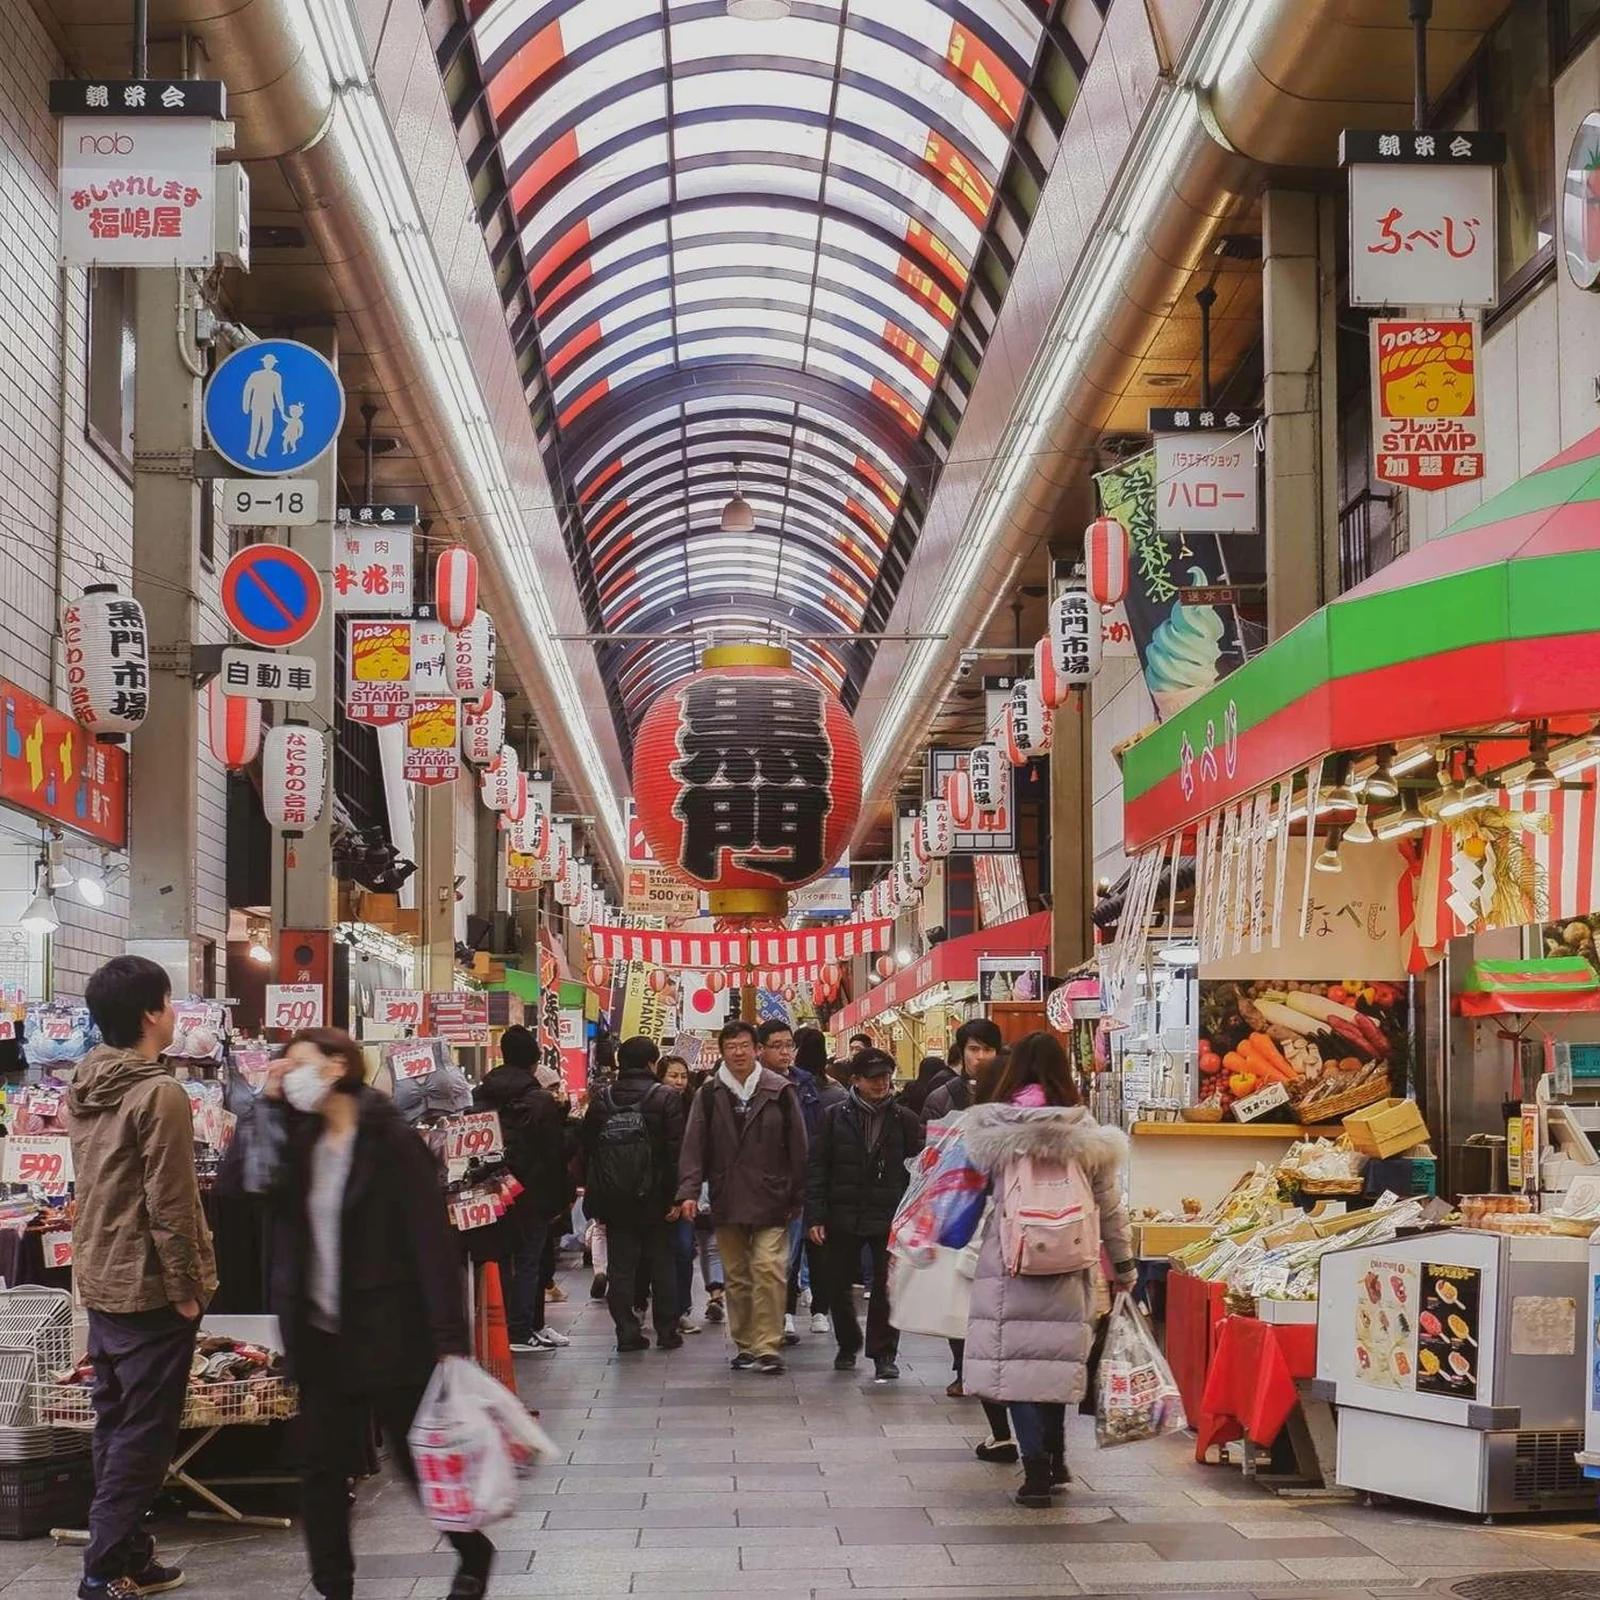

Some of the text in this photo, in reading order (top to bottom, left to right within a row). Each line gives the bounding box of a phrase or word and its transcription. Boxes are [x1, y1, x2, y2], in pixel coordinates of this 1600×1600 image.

[79, 132, 134, 155] nob
[70, 176, 202, 211] おしゃれします
[89, 206, 182, 239] 福嶋屋
[1381, 327, 1441, 351] クロモン
[1389, 418, 1465, 433] フレッシュ
[1382, 433, 1477, 452] STAMP
[1172, 453, 1240, 467] バラエティショップ
[1384, 455, 1478, 477] 加盟店
[1168, 483, 1245, 508] ハロー
[354, 626, 392, 639] クロモン
[1060, 597, 1090, 674] 黒門市場
[64, 606, 97, 724] なにわの台所
[105, 601, 147, 720] 黒門市場
[227, 662, 312, 690] 自動車
[357, 682, 403, 691] フレッシュ
[351, 690, 410, 702] STAMP
[351, 704, 411, 718] 加盟店
[1012, 683, 1032, 750] 黒門市場
[407, 756, 456, 766] STAMP
[408, 768, 456, 779] 加盟店
[284, 732, 307, 823] なにわの台所
[972, 749, 992, 804] 黒門市場
[936, 803, 948, 852] ほんまもん
[276, 1000, 316, 1027] 599
[455, 1127, 494, 1156] 199
[19, 1153, 62, 1181] 599
[461, 1203, 491, 1228] 199
